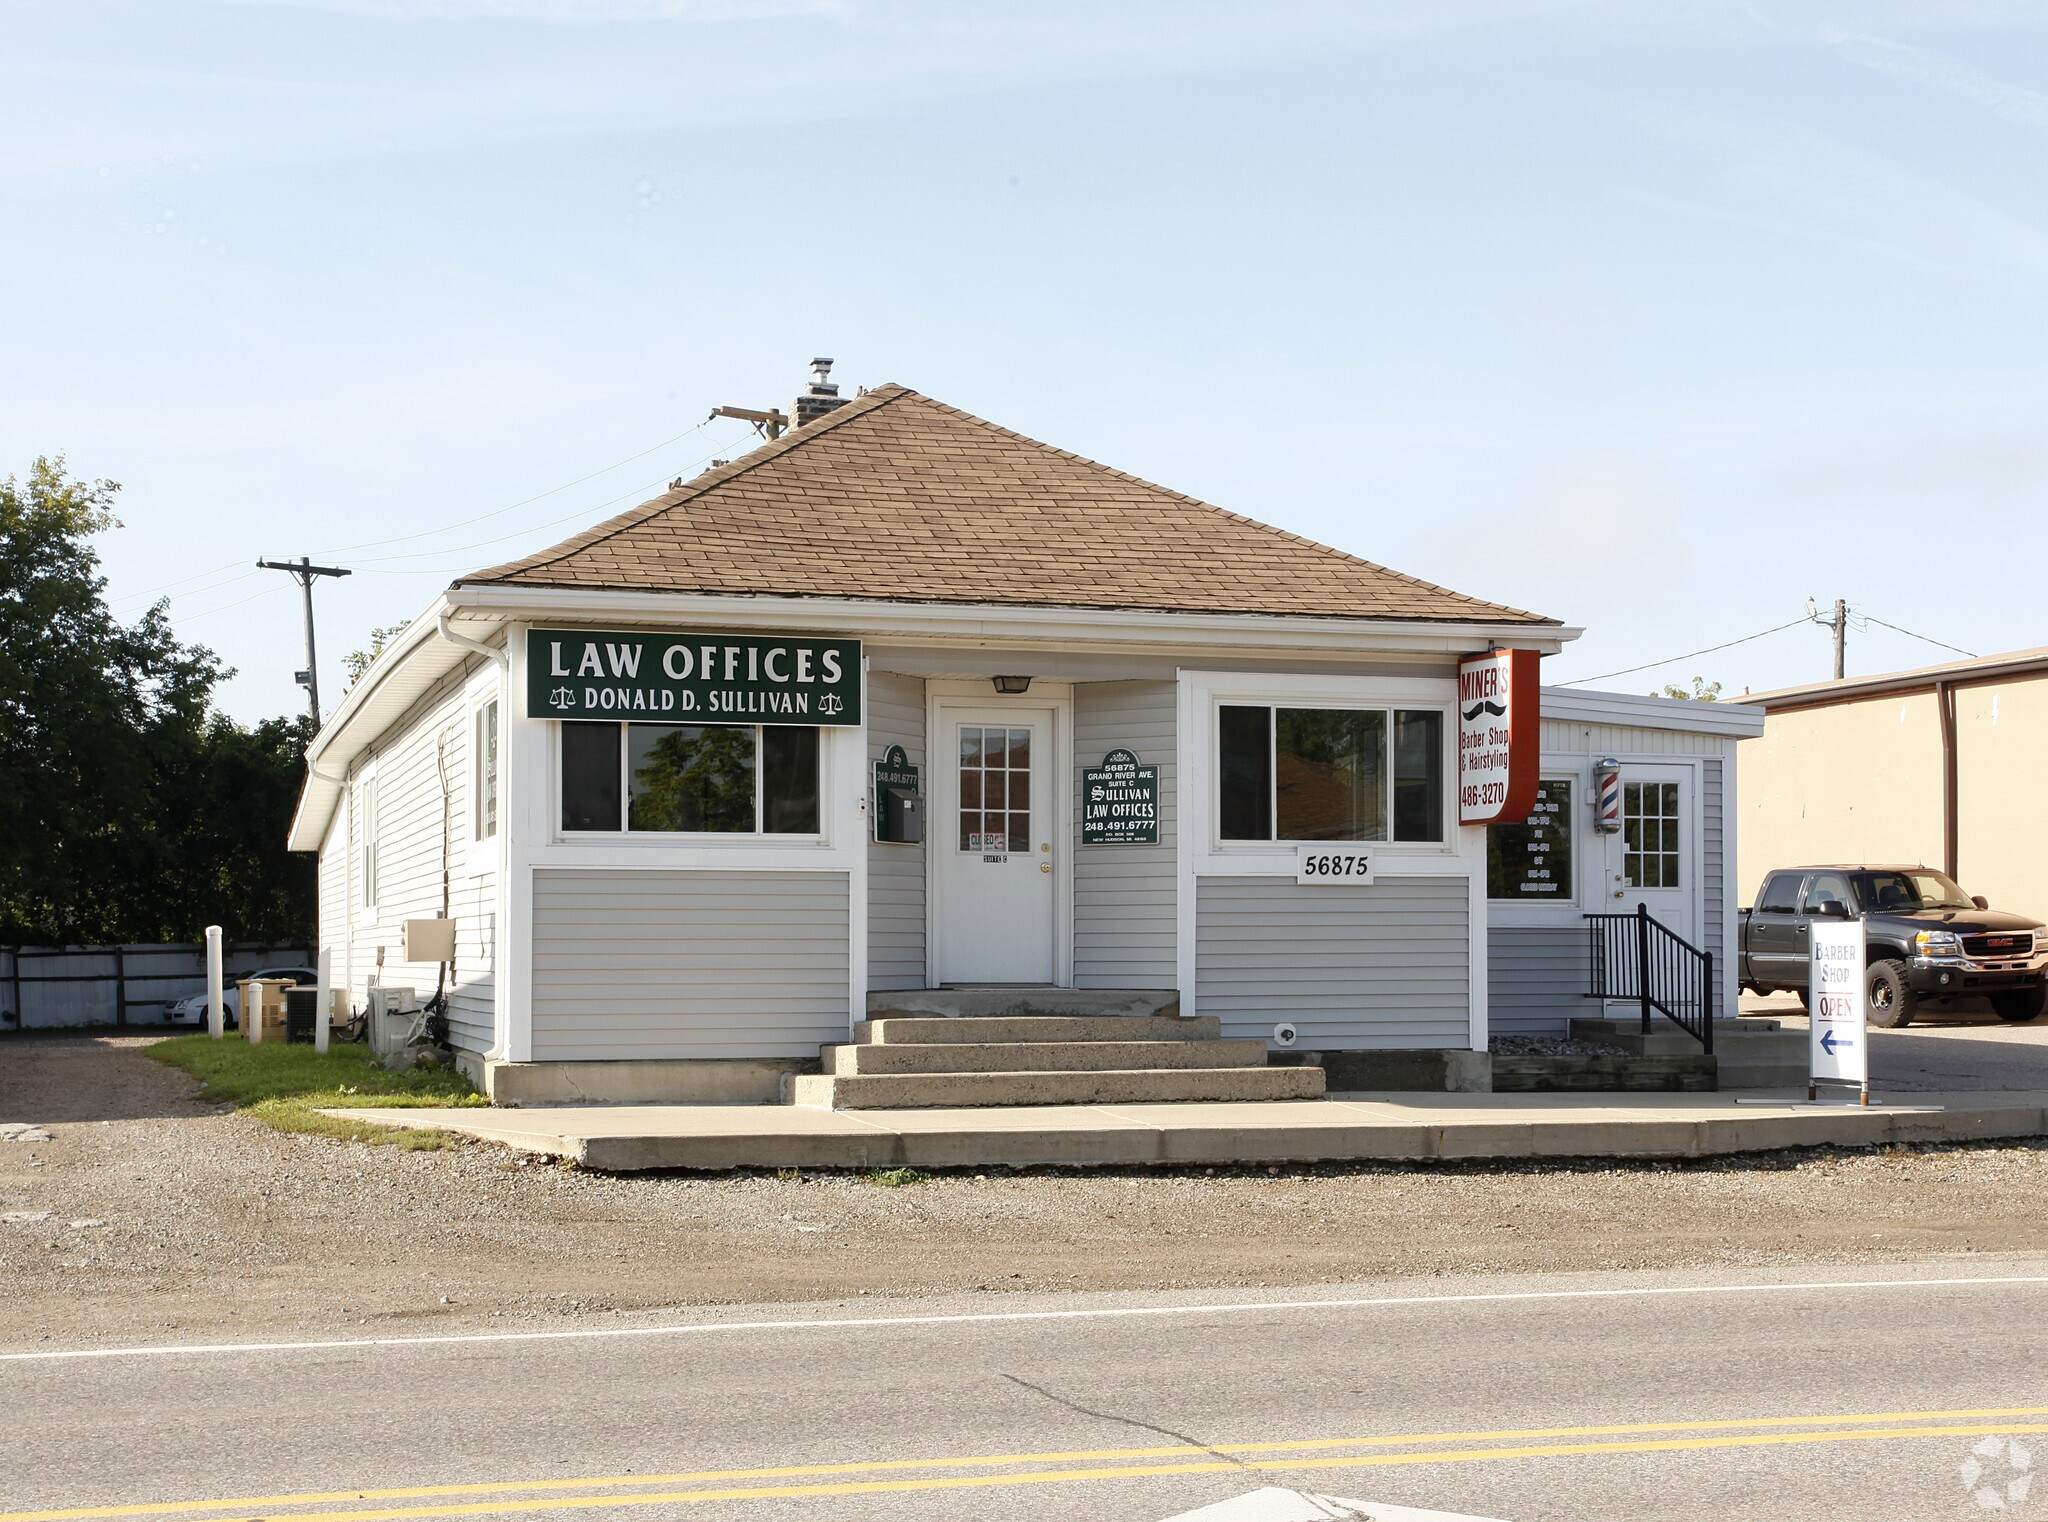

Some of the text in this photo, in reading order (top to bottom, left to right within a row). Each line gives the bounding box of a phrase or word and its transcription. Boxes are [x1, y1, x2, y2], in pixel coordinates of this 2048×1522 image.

[550, 642, 843, 684] LAW OFFICES
[1461, 667, 1508, 702] MINER'S
[584, 687, 808, 714] DONALD D. SULLIVAN
[1461, 727, 1509, 750] Barber Shop
[1461, 749, 1508, 772] & Hairstyling
[877, 771, 917, 784] 248.491.6777
[1091, 786, 1150, 801] SULLIVAN
[1461, 781, 1504, 807] 486-3270
[1087, 803, 1154, 819] LAW OFFICES
[1085, 821, 1155, 830] 248.491.6777
[983, 855, 1001, 863] SUITE
[1305, 855, 1368, 875] 56875
[1815, 942, 1856, 961] BARBER
[1821, 964, 1850, 983] SHOP
[1819, 997, 1852, 1016] OPEN
